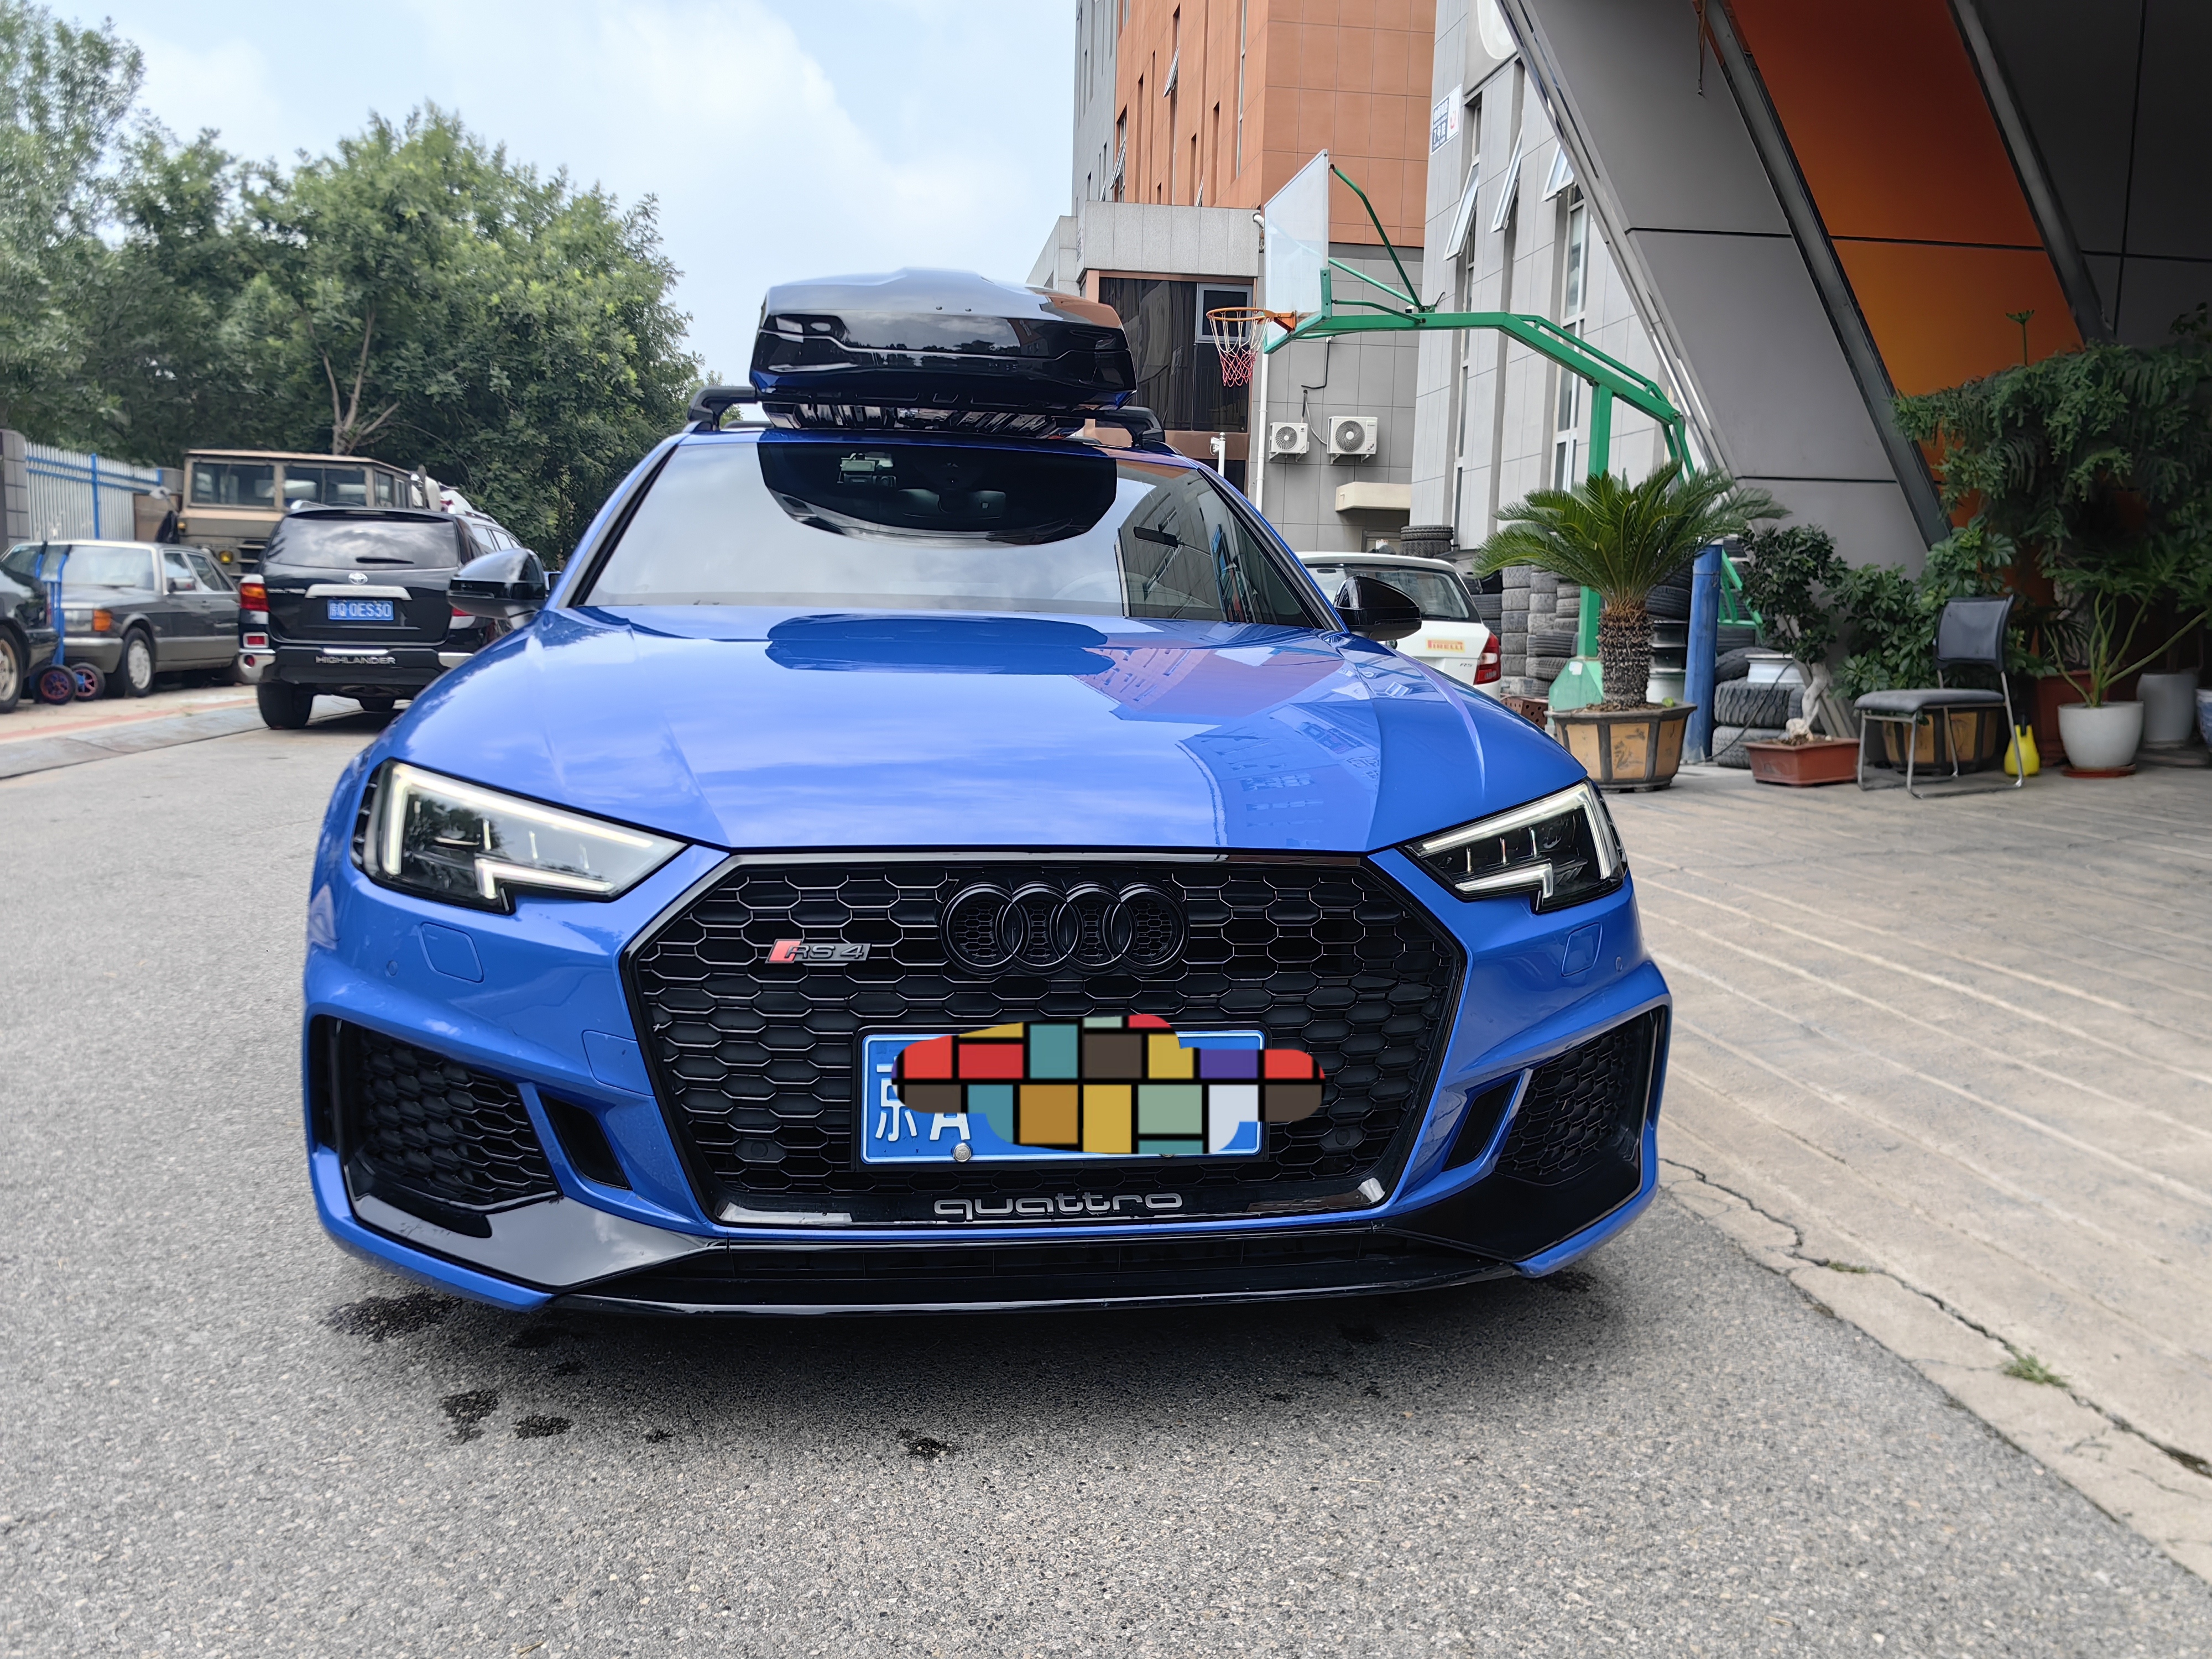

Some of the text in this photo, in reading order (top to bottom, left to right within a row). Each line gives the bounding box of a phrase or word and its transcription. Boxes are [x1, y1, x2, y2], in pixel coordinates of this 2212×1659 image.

[1428, 640, 1463, 650] PIRELLI
[315, 655, 396, 664] HIGHLANDER
[934, 1192, 1182, 1221] quattro
